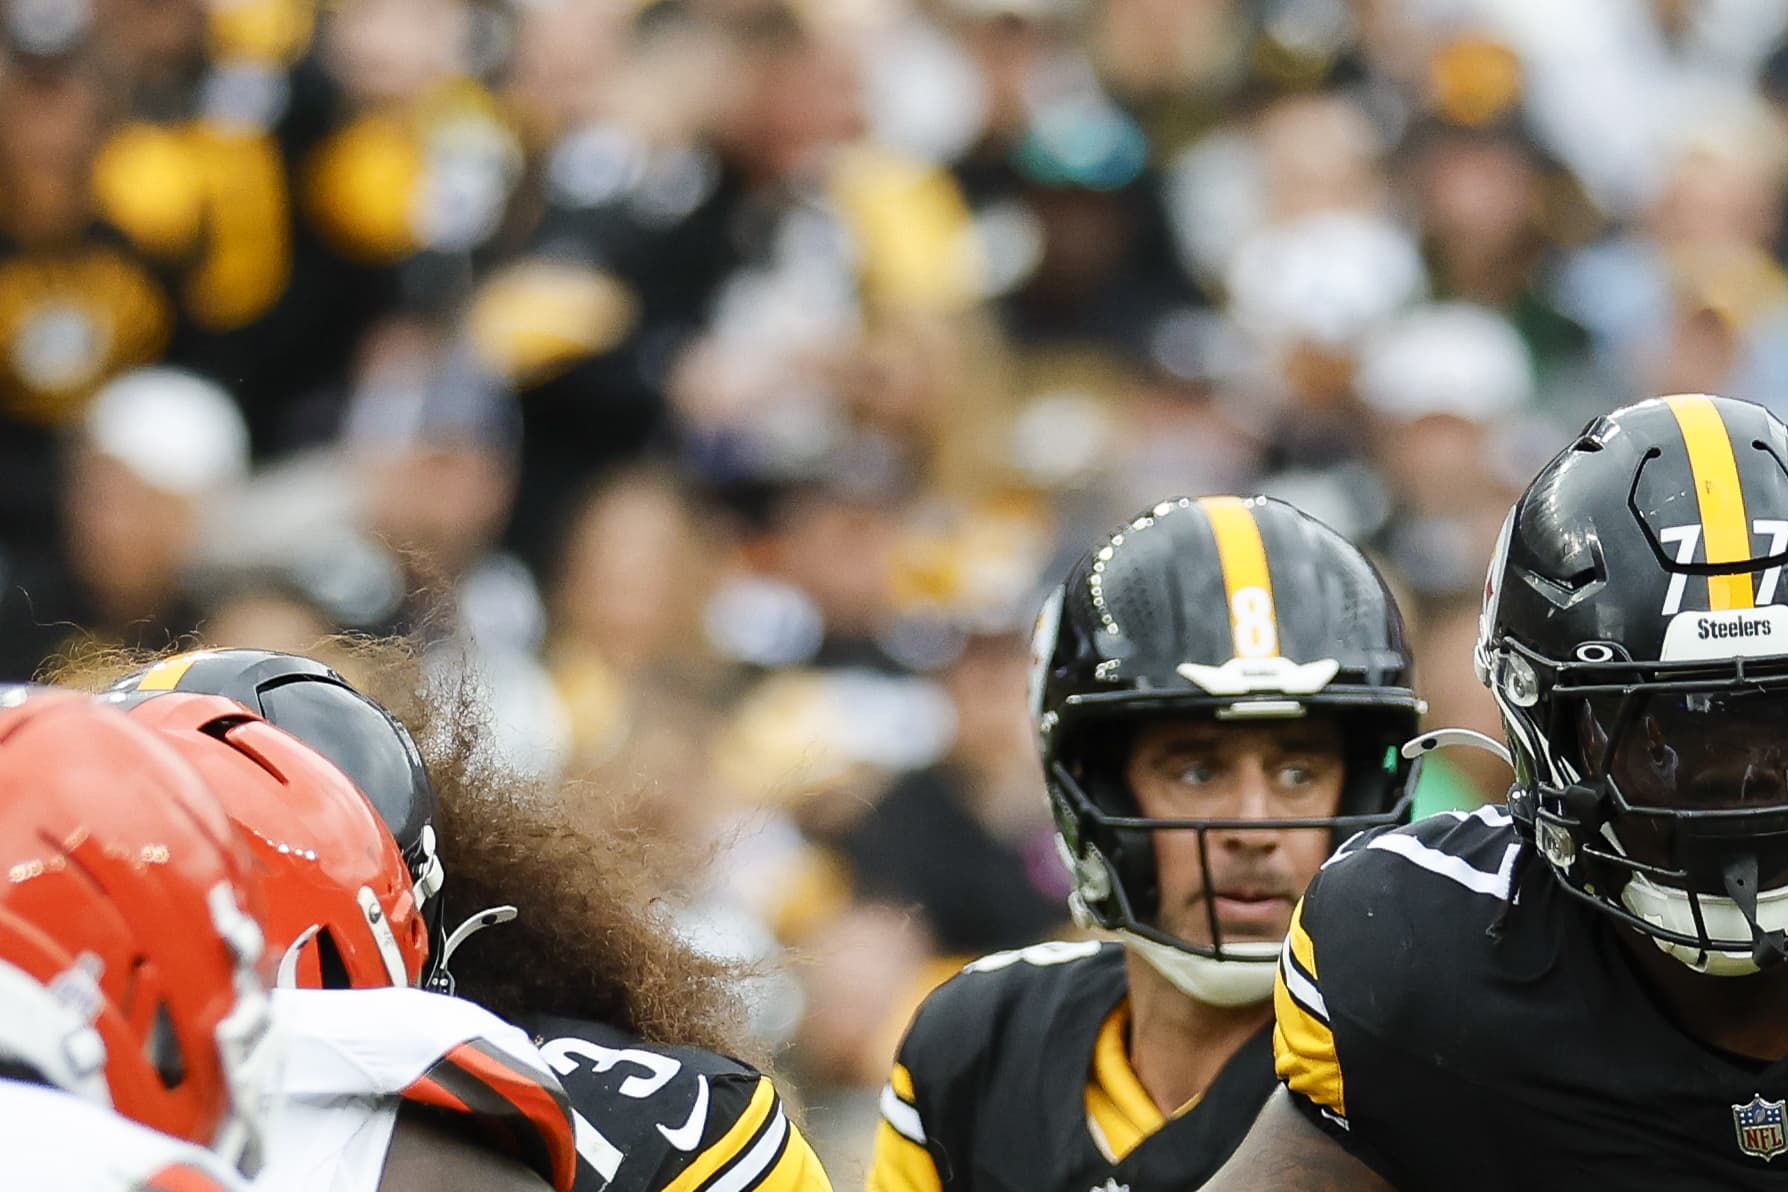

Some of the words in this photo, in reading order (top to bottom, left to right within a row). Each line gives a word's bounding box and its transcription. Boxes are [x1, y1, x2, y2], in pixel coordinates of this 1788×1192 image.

[1231, 586, 1277, 658] 8
[1697, 616, 1772, 640] Steelers
[1744, 1126, 1783, 1152] NFL
